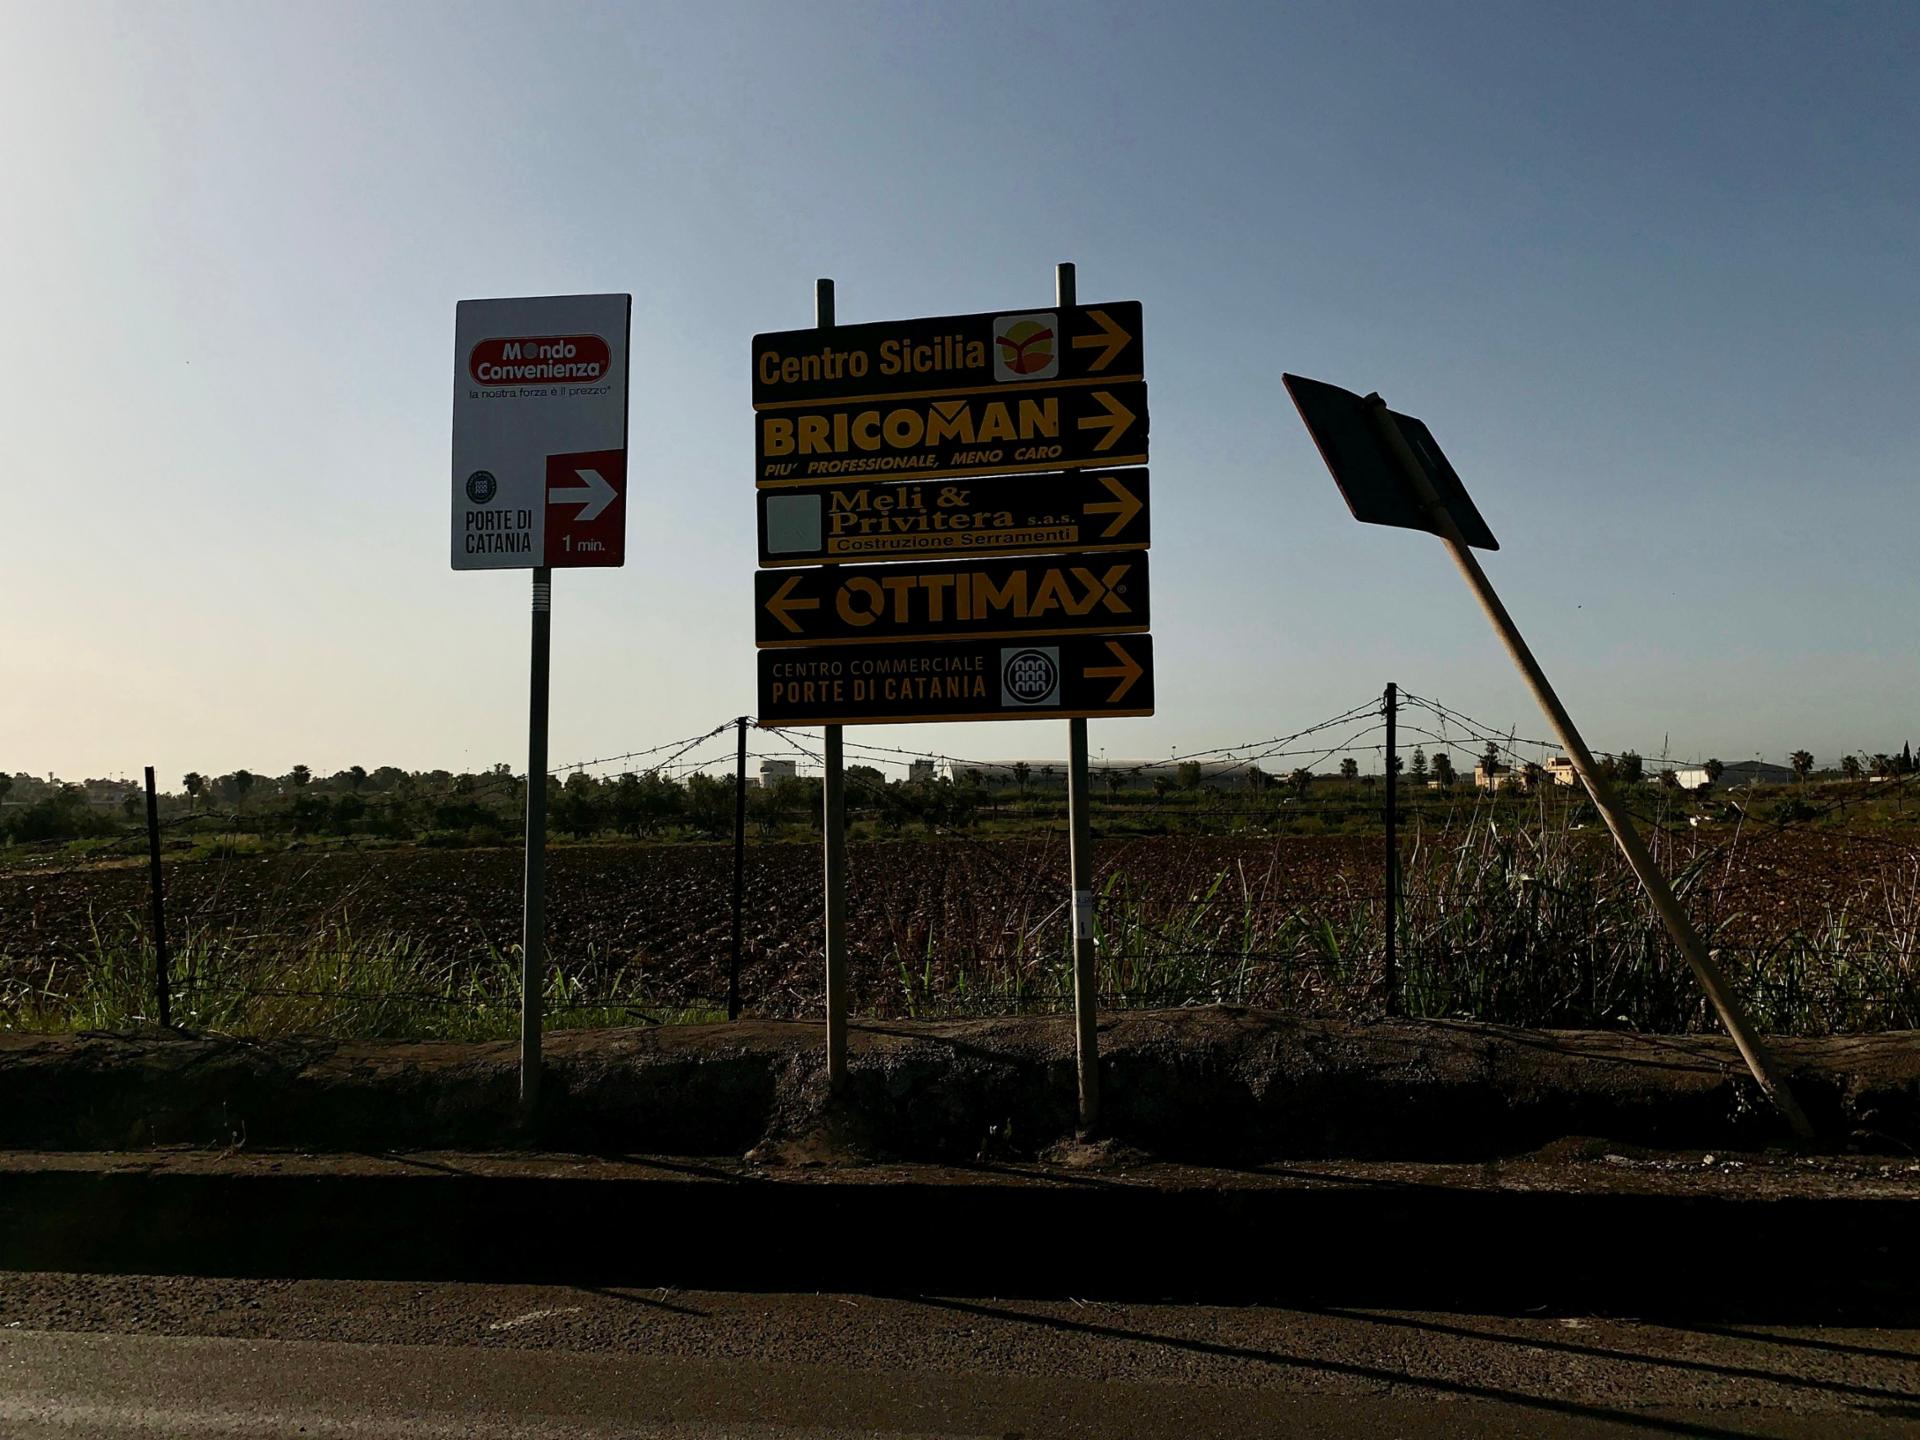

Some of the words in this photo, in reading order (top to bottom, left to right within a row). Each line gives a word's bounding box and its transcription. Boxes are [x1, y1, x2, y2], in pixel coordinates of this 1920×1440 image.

[477, 360, 600, 380] Convenienza
[758, 345, 869, 385] Centro
[879, 335, 986, 375] Sicilia
[469, 390, 479, 399] la
[481, 389, 516, 399] nostra
[519, 387, 547, 398] forza
[550, 387, 558, 396] è
[561, 386, 566, 396] il
[763, 396, 1060, 458] BRICOMAN
[807, 454, 940, 475] PROFESSIONALE,
[950, 449, 1004, 465] MENO
[1014, 444, 1063, 461] CARO
[828, 487, 924, 513] Meli
[936, 486, 971, 510] &
[466, 510, 512, 531] PORTE
[517, 509, 532, 530] DI
[828, 508, 1016, 535] Privitera
[1026, 513, 1076, 526] s.a.s.
[466, 532, 532, 553] CATANIA
[562, 534, 571, 552] 1
[577, 538, 606, 552] min.
[836, 534, 955, 551] Costruzione
[960, 528, 1071, 546] Serramenti
[772, 661, 843, 677] CENTRO
[850, 656, 984, 676] COMMERCIALE
[771, 680, 844, 704] PORTE
[853, 678, 875, 702] DI
[883, 674, 988, 701] CATANIA
